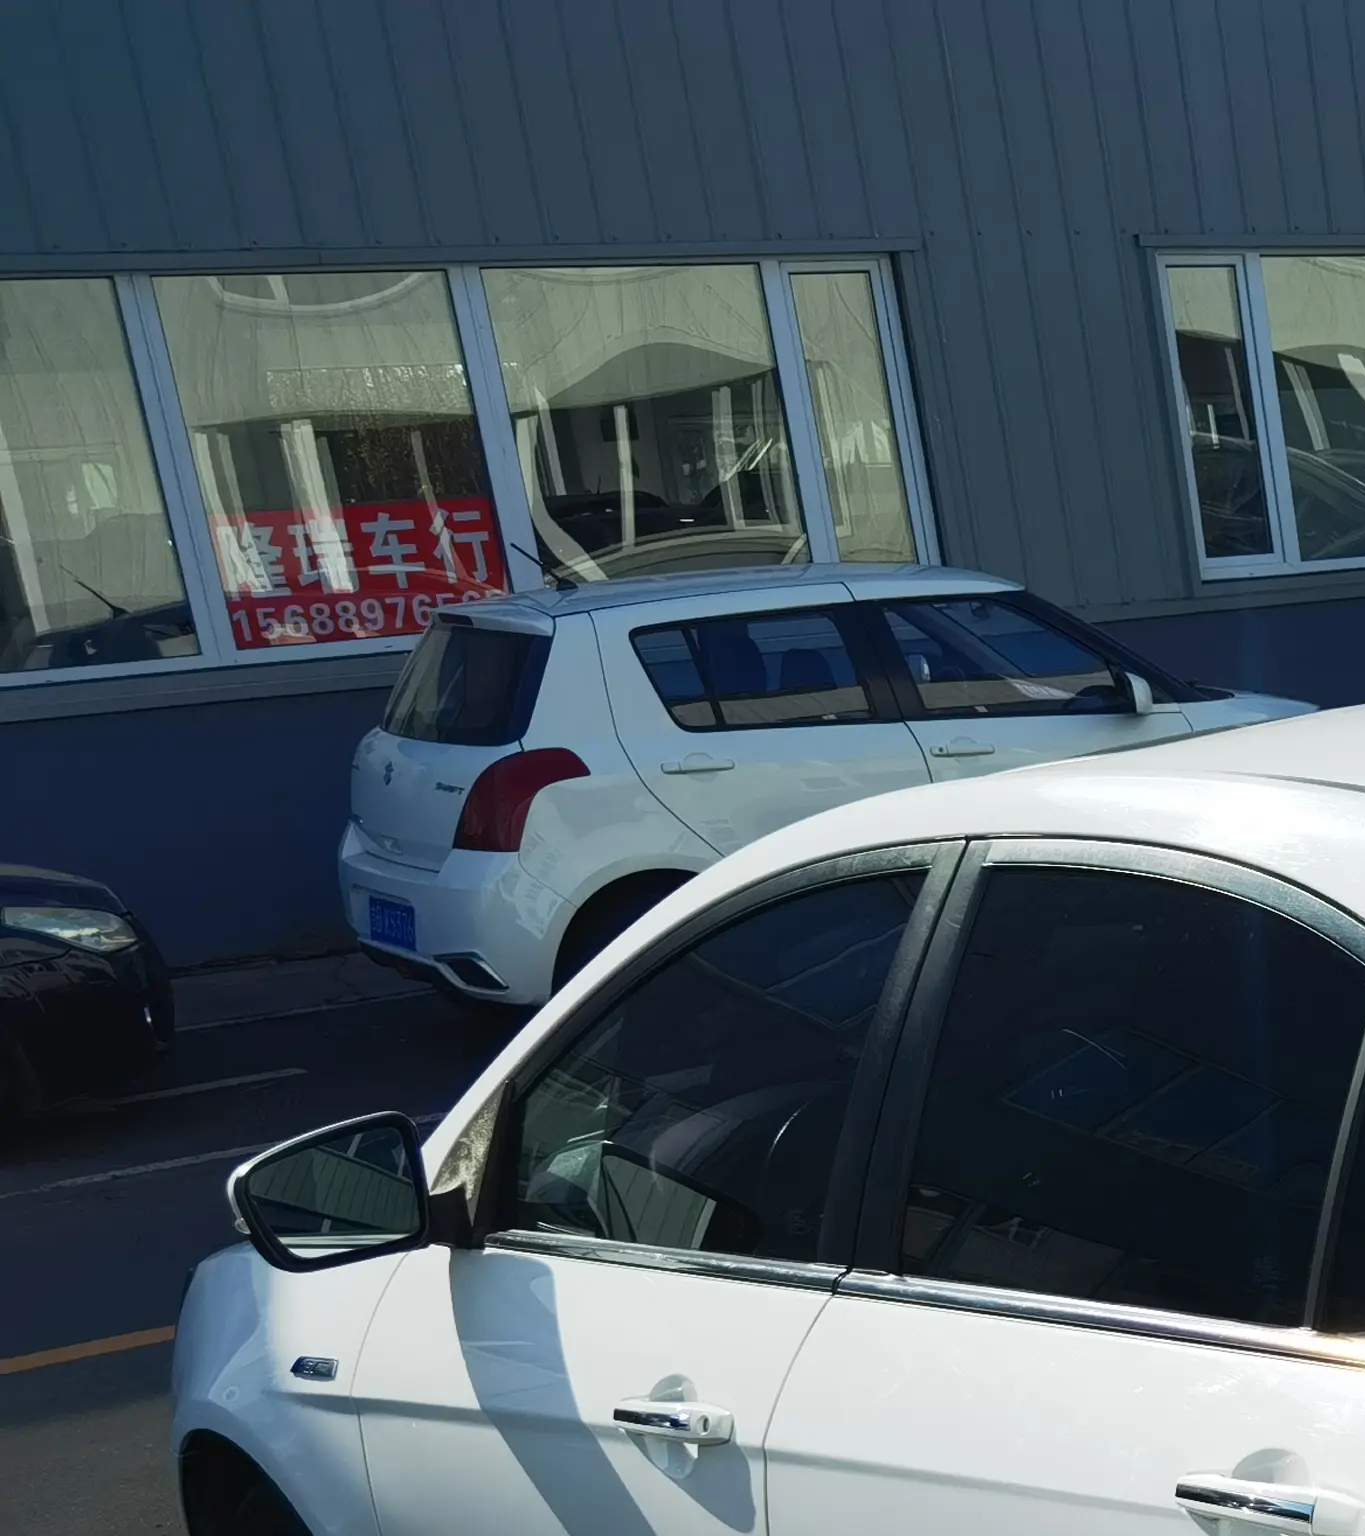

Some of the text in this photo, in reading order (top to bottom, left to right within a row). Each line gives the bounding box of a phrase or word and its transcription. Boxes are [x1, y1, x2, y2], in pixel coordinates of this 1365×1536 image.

[216, 508, 491, 600] 隆瑞车行
[232, 589, 508, 643] 15688976
